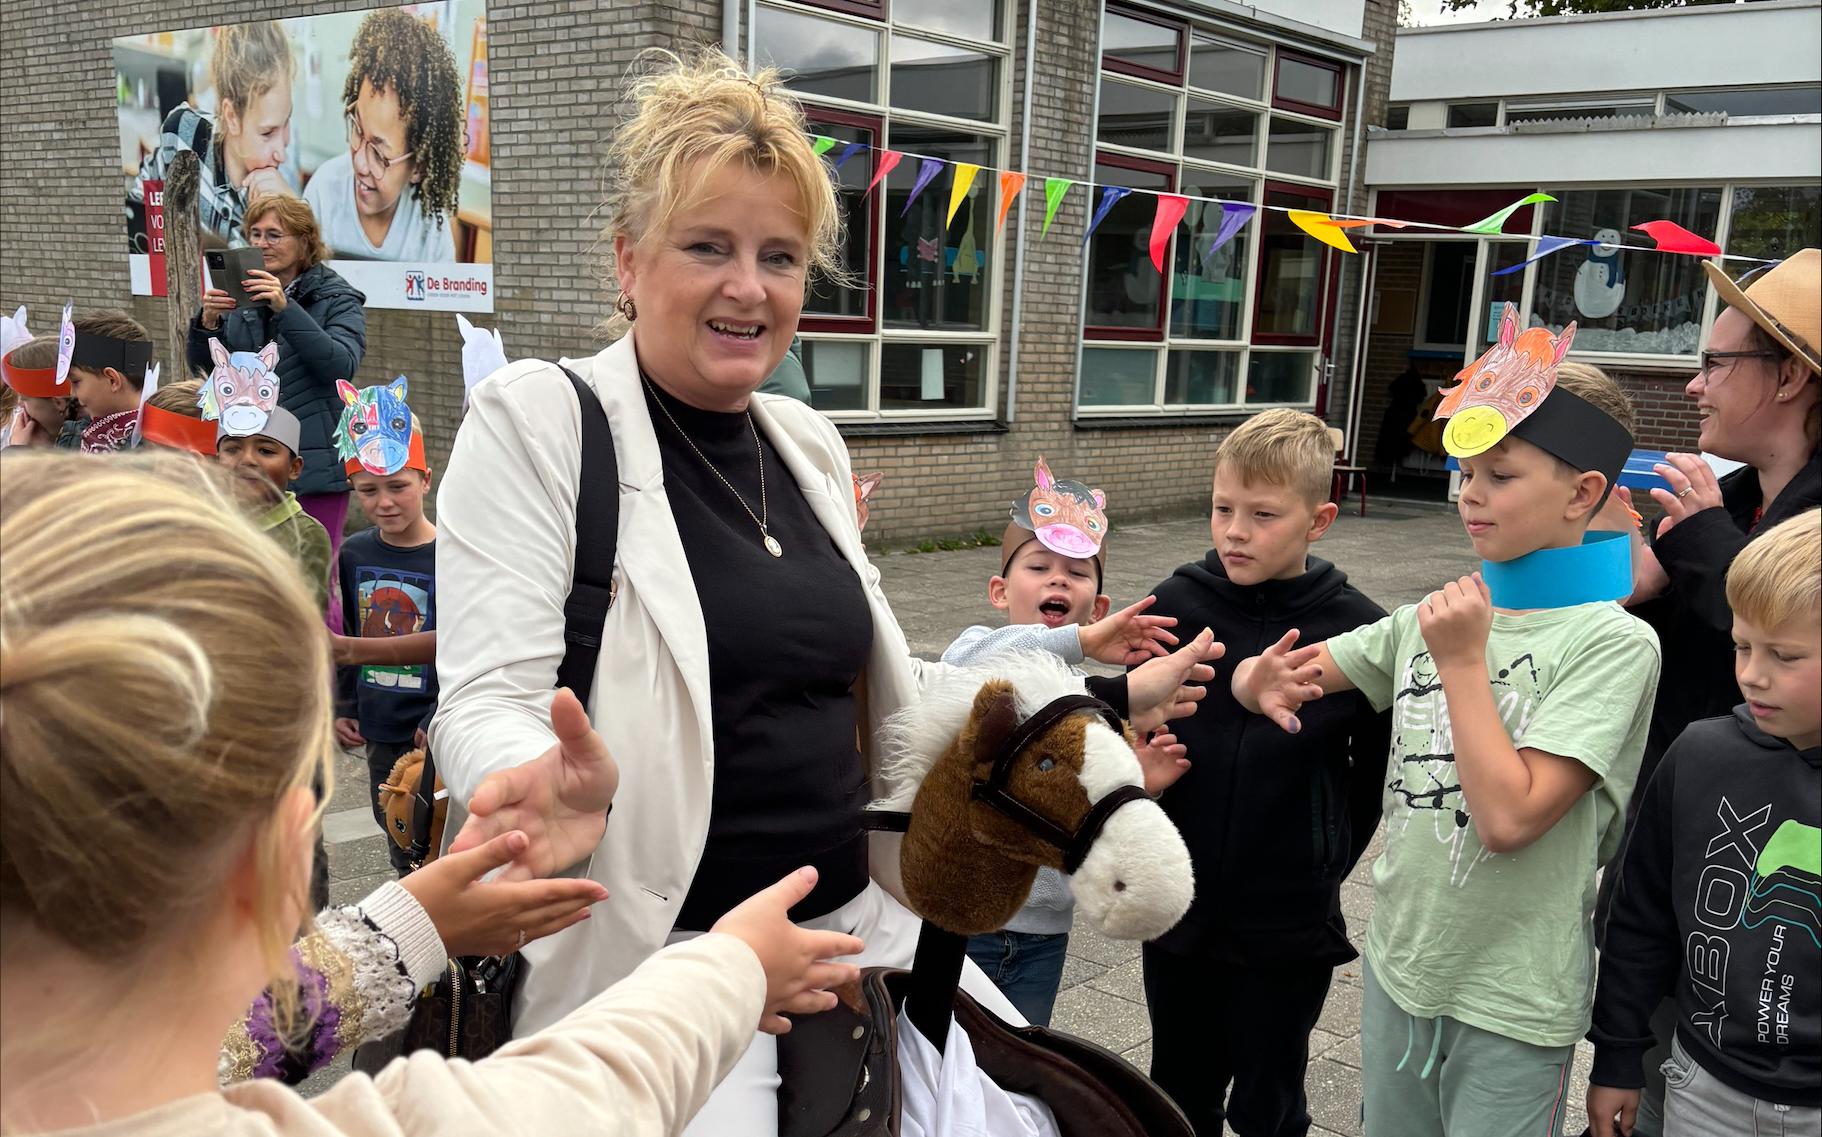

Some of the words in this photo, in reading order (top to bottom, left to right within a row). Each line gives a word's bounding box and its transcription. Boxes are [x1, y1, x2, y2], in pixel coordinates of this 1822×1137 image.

[151, 214, 164, 229] VO
[427, 276, 440, 290] De
[443, 277, 487, 296] Branding
[1686, 796, 1772, 1050] XBOX
[1764, 924, 1787, 976] YOUR
[1757, 978, 1775, 1044] POWER
[1776, 974, 1795, 1045] DREAMS
